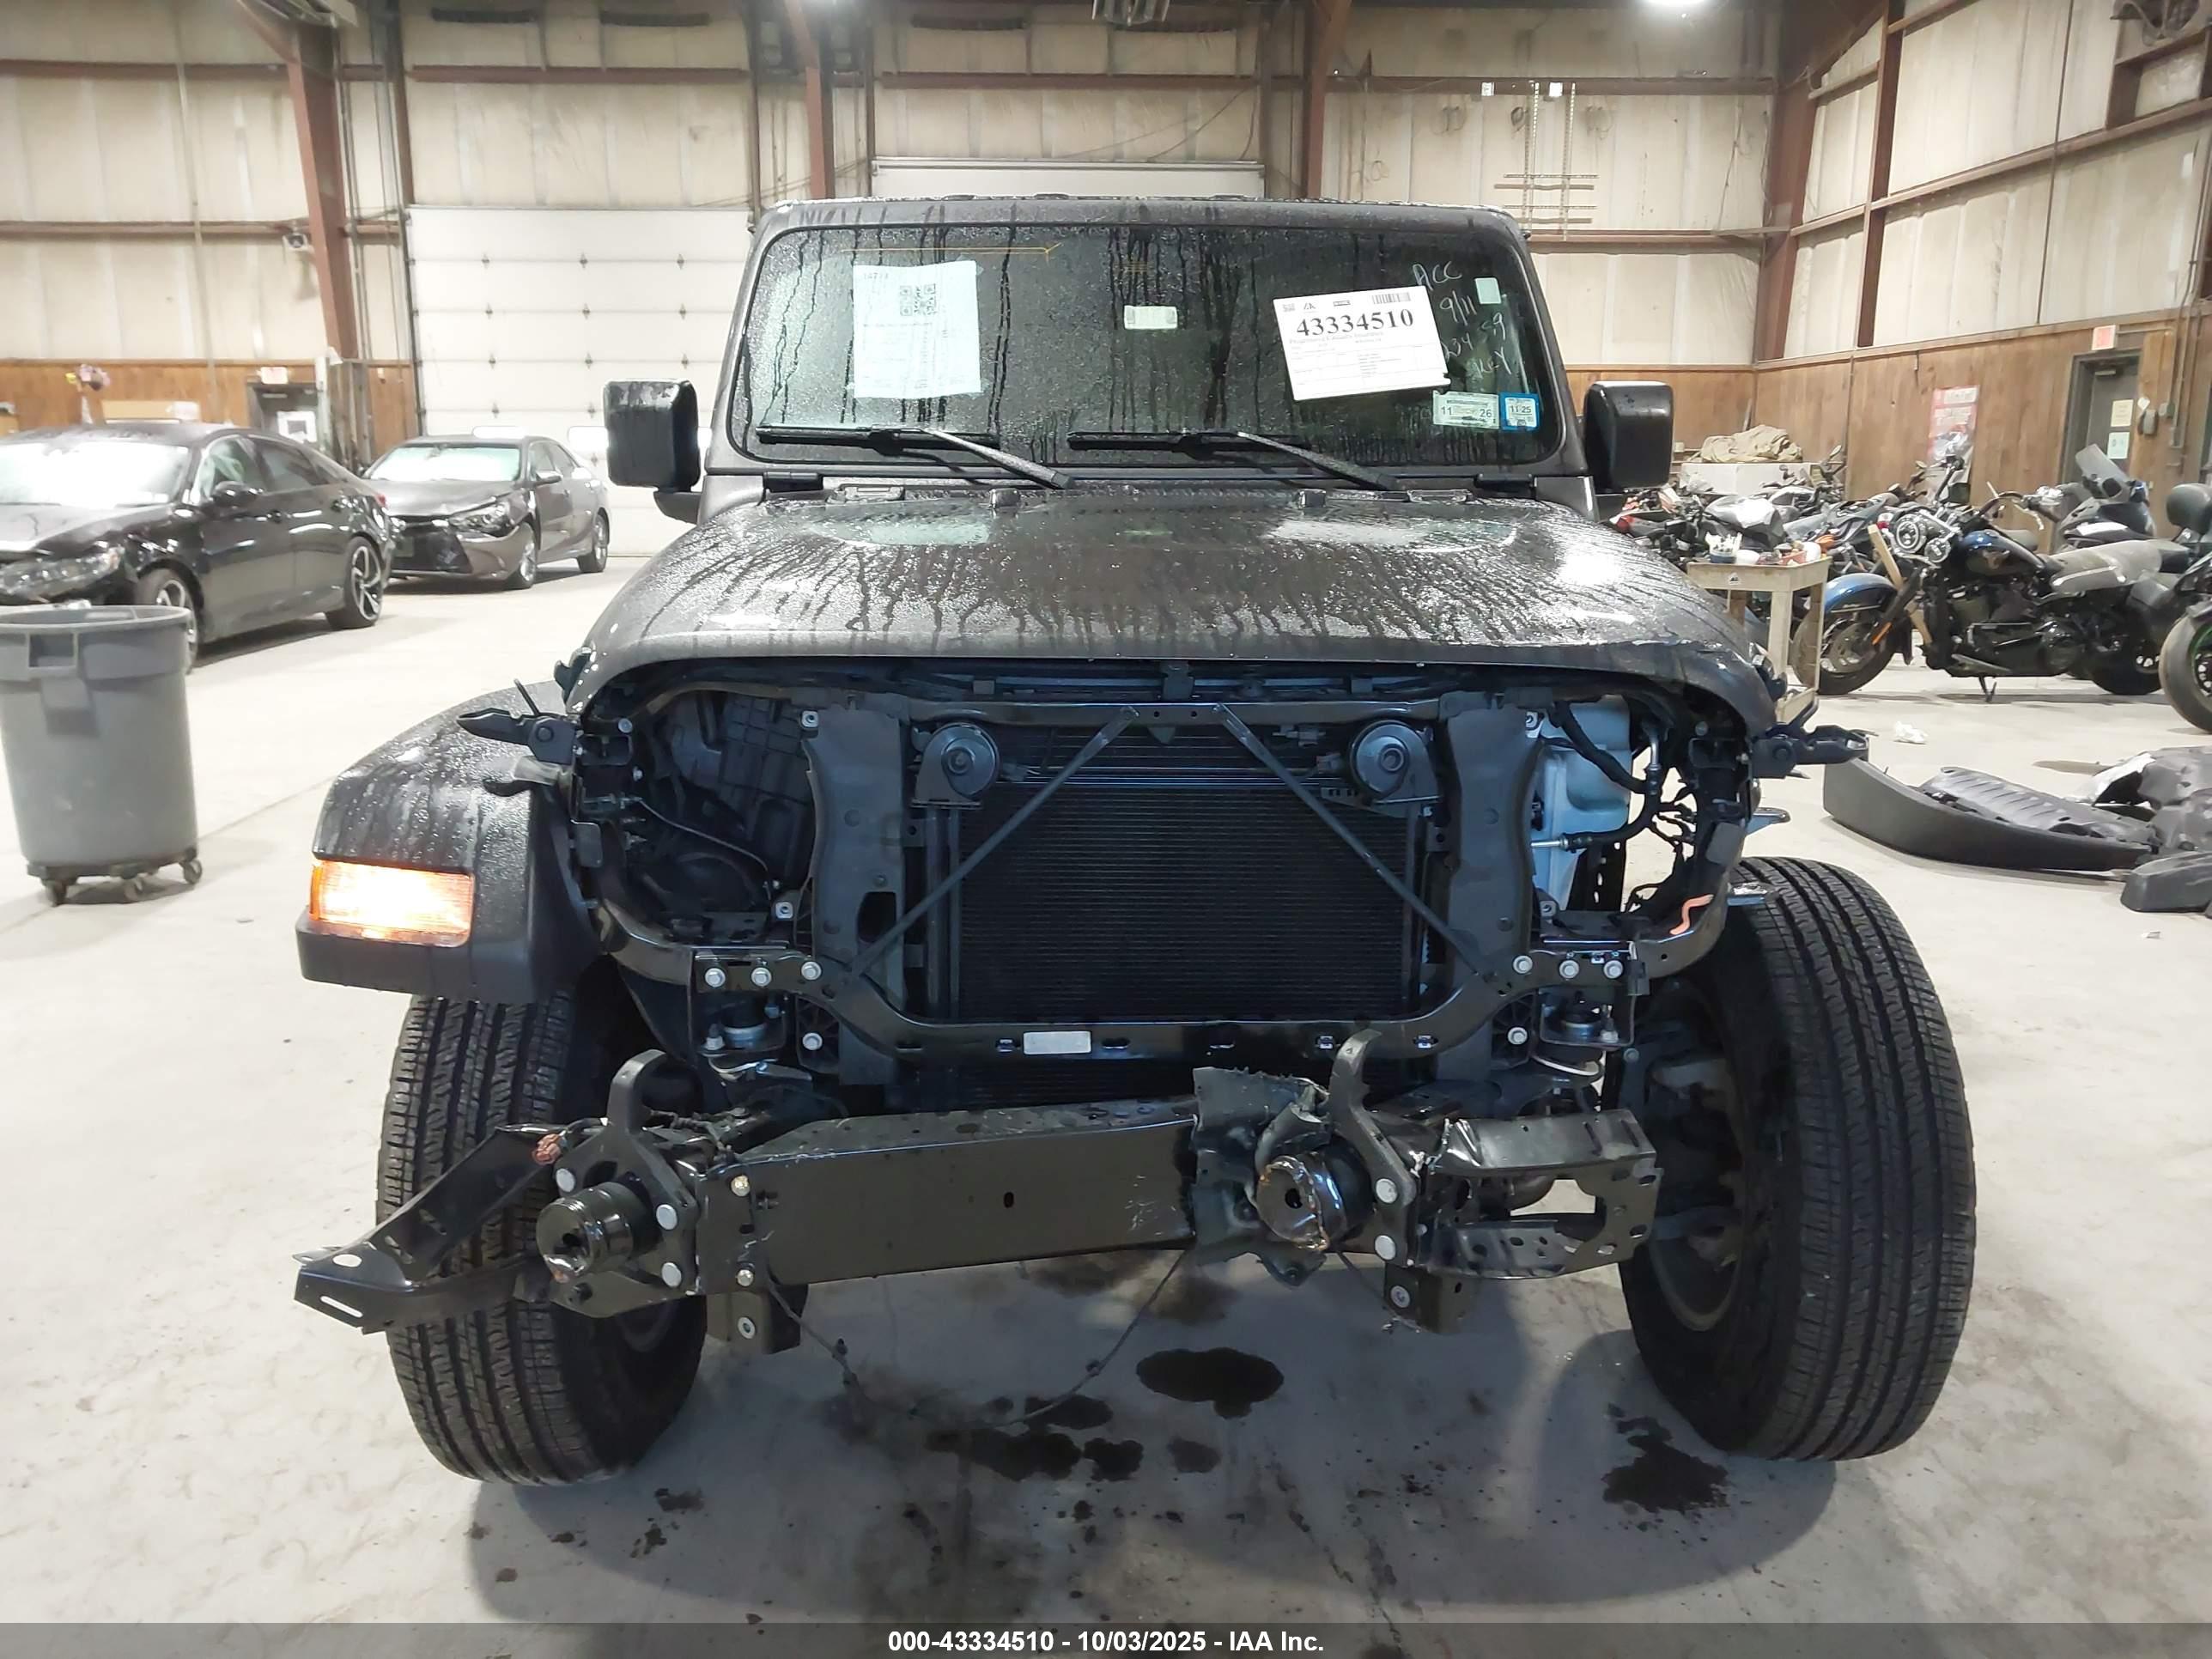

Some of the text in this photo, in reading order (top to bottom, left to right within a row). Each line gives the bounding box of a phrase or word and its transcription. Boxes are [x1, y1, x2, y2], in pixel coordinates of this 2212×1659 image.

[1413, 260, 1462, 291] ACC
[1297, 308, 1413, 336] 43334510
[1439, 290, 1477, 326] 9/11
[1441, 406, 1492, 418] 11 26
